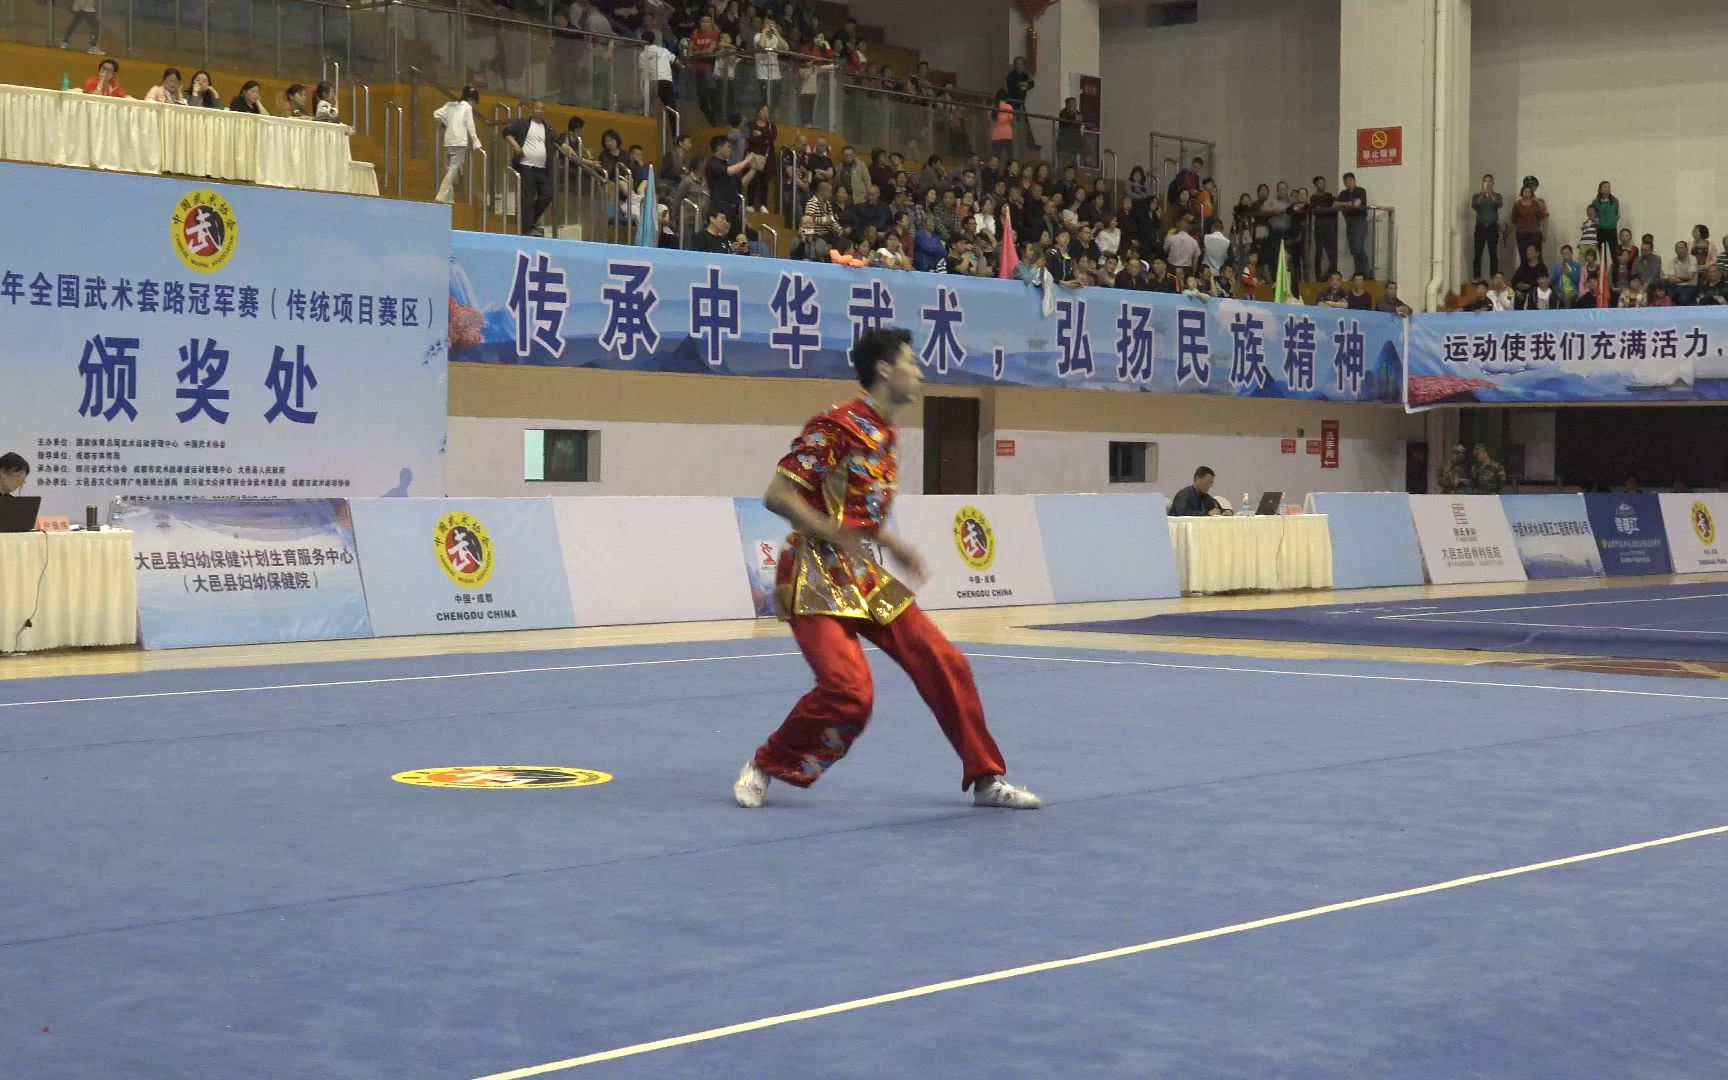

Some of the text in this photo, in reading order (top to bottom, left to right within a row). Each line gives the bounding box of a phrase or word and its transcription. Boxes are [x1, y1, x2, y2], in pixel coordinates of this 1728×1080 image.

[1443, 327, 1724, 363] 运动使我们充满活力，
[78, 333, 318, 425] 颁奖处
[134, 547, 354, 571] 大邑县妇幼保健计划生育服务中心
[436, 609, 518, 621] CHENGDU CHINA
